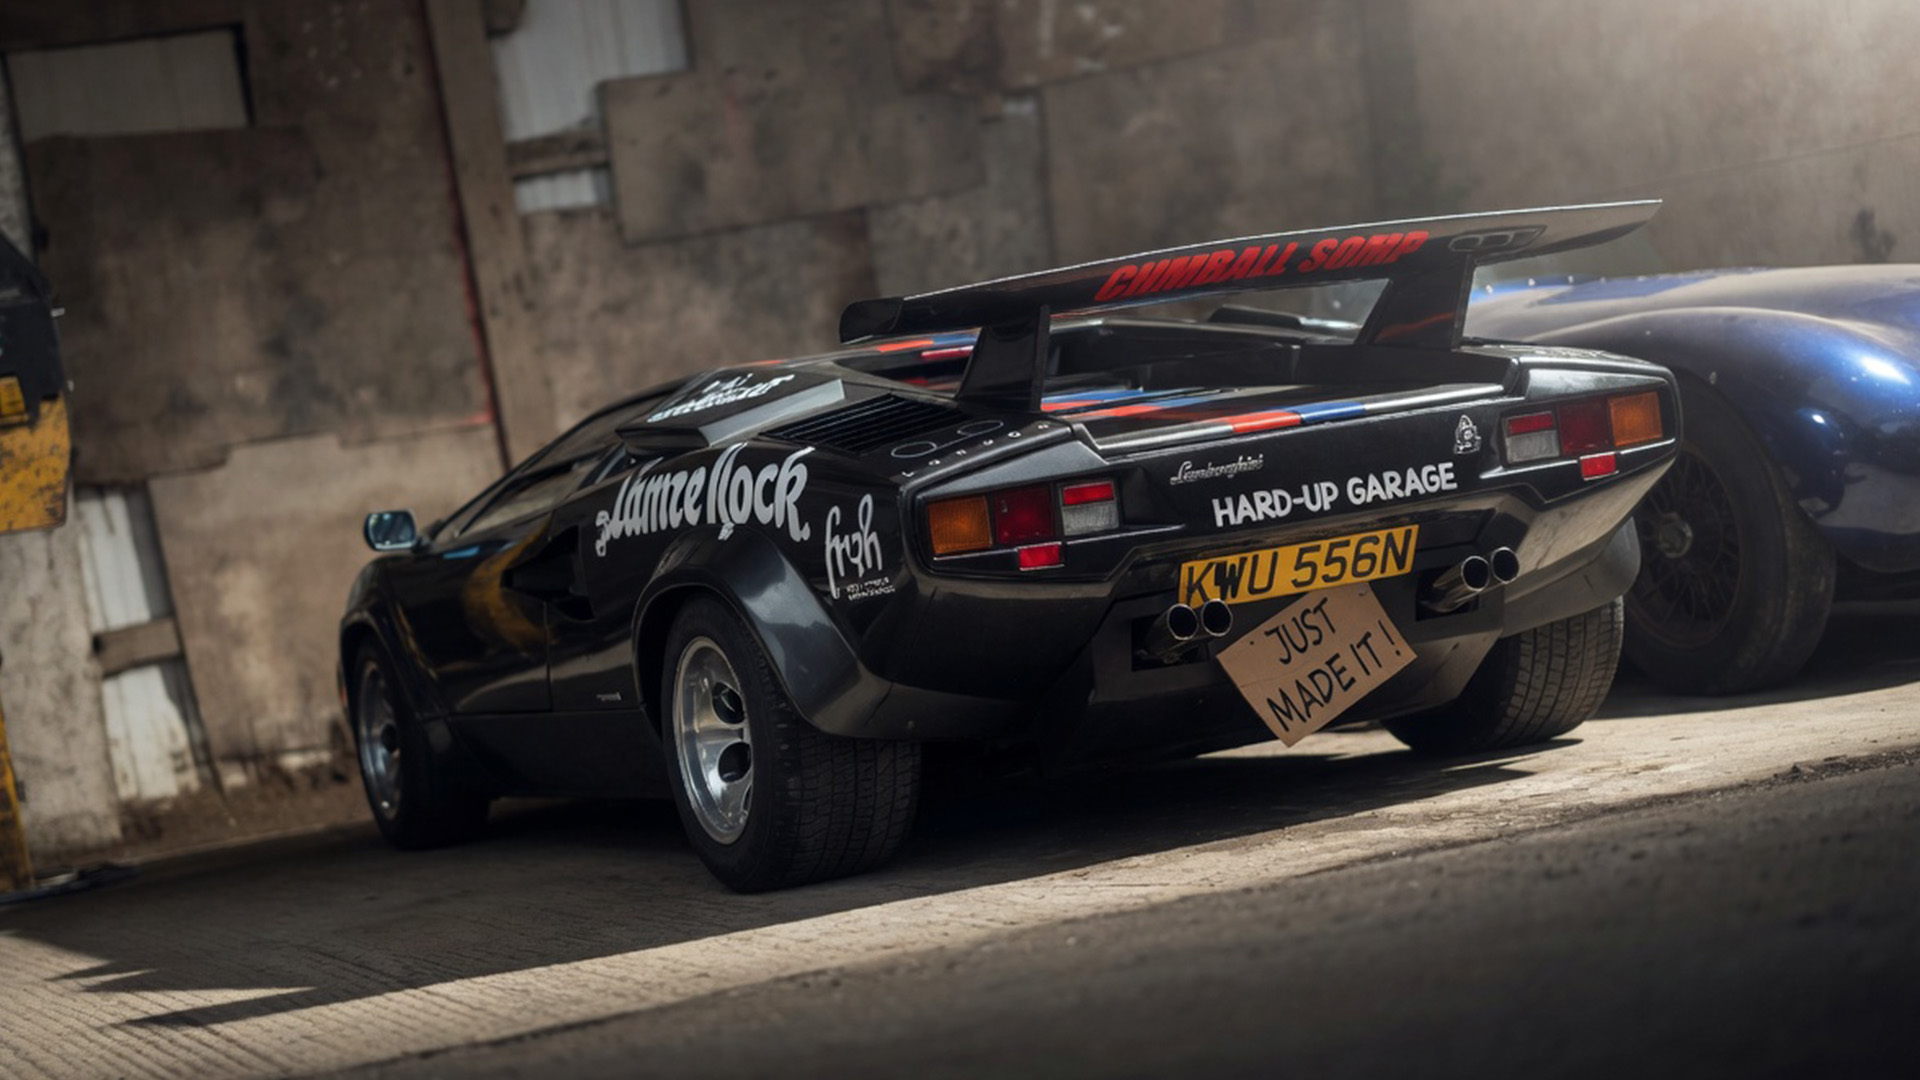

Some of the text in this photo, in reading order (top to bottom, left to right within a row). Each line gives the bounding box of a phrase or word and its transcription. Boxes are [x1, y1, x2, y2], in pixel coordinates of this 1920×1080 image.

[1212, 462, 1458, 527] HARD-UP GARAGE
[1185, 529, 1412, 608] KWU 556N
[1264, 596, 1336, 665] JUST
[1266, 652, 1356, 732] MADE
